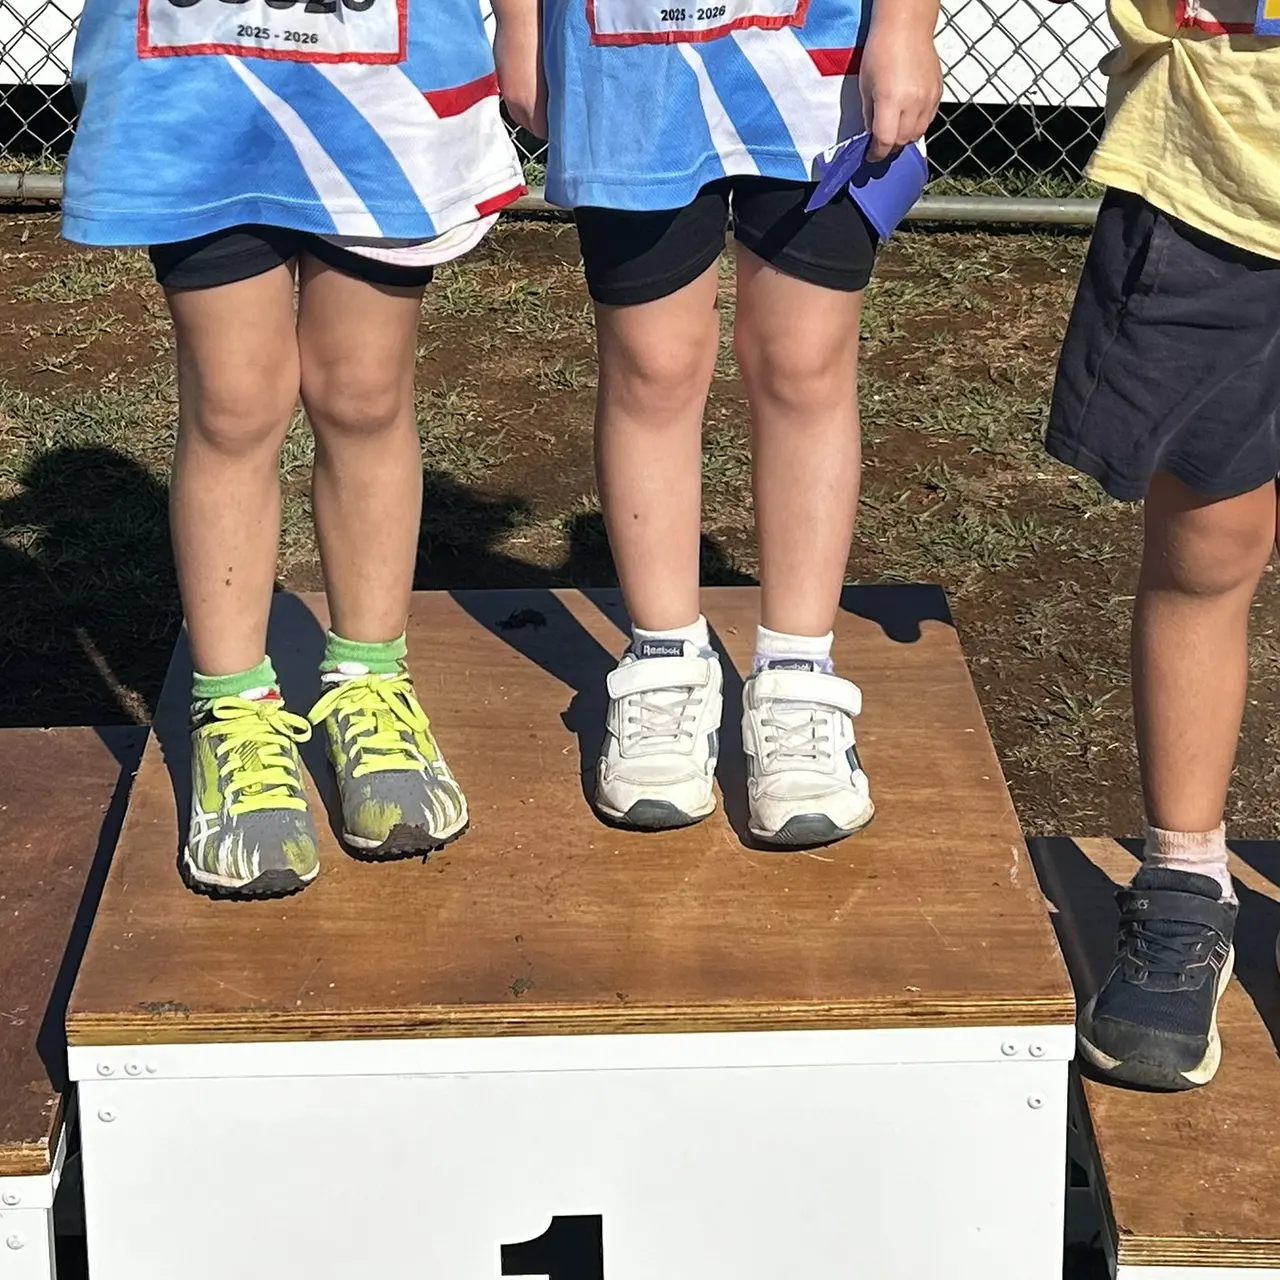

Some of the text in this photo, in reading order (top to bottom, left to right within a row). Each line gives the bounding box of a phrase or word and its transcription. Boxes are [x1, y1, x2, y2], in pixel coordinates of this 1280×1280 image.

[660, 8, 686, 21] 2025
[696, 5, 727, 20] 2026
[236, 24, 271, 39] 2025
[283, 30, 319, 44] 2026
